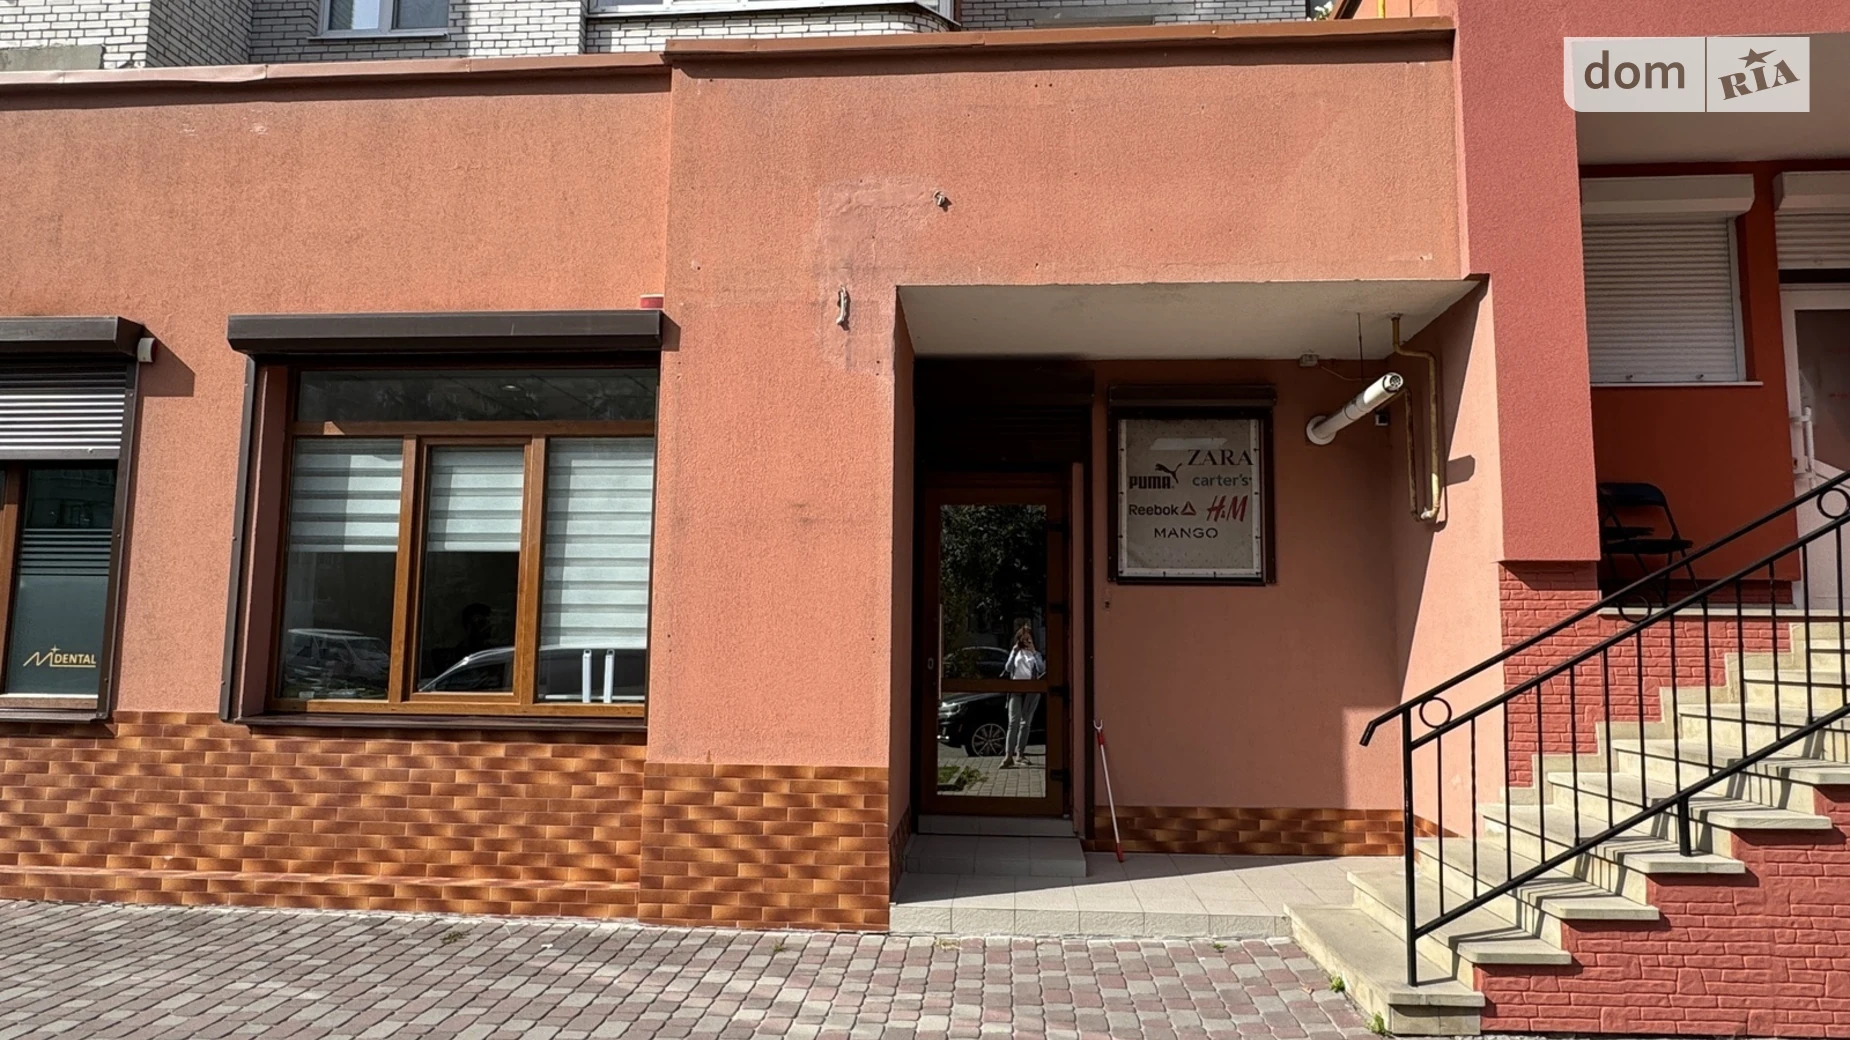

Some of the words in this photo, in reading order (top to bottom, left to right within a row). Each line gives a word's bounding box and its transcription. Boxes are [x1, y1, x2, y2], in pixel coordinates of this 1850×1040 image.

[1187, 449, 1253, 466] ZARA
[1129, 476, 1171, 489] PUMA
[1128, 504, 1179, 516] Reebok
[1206, 495, 1249, 522] H&M
[1154, 527, 1219, 539] MANGO
